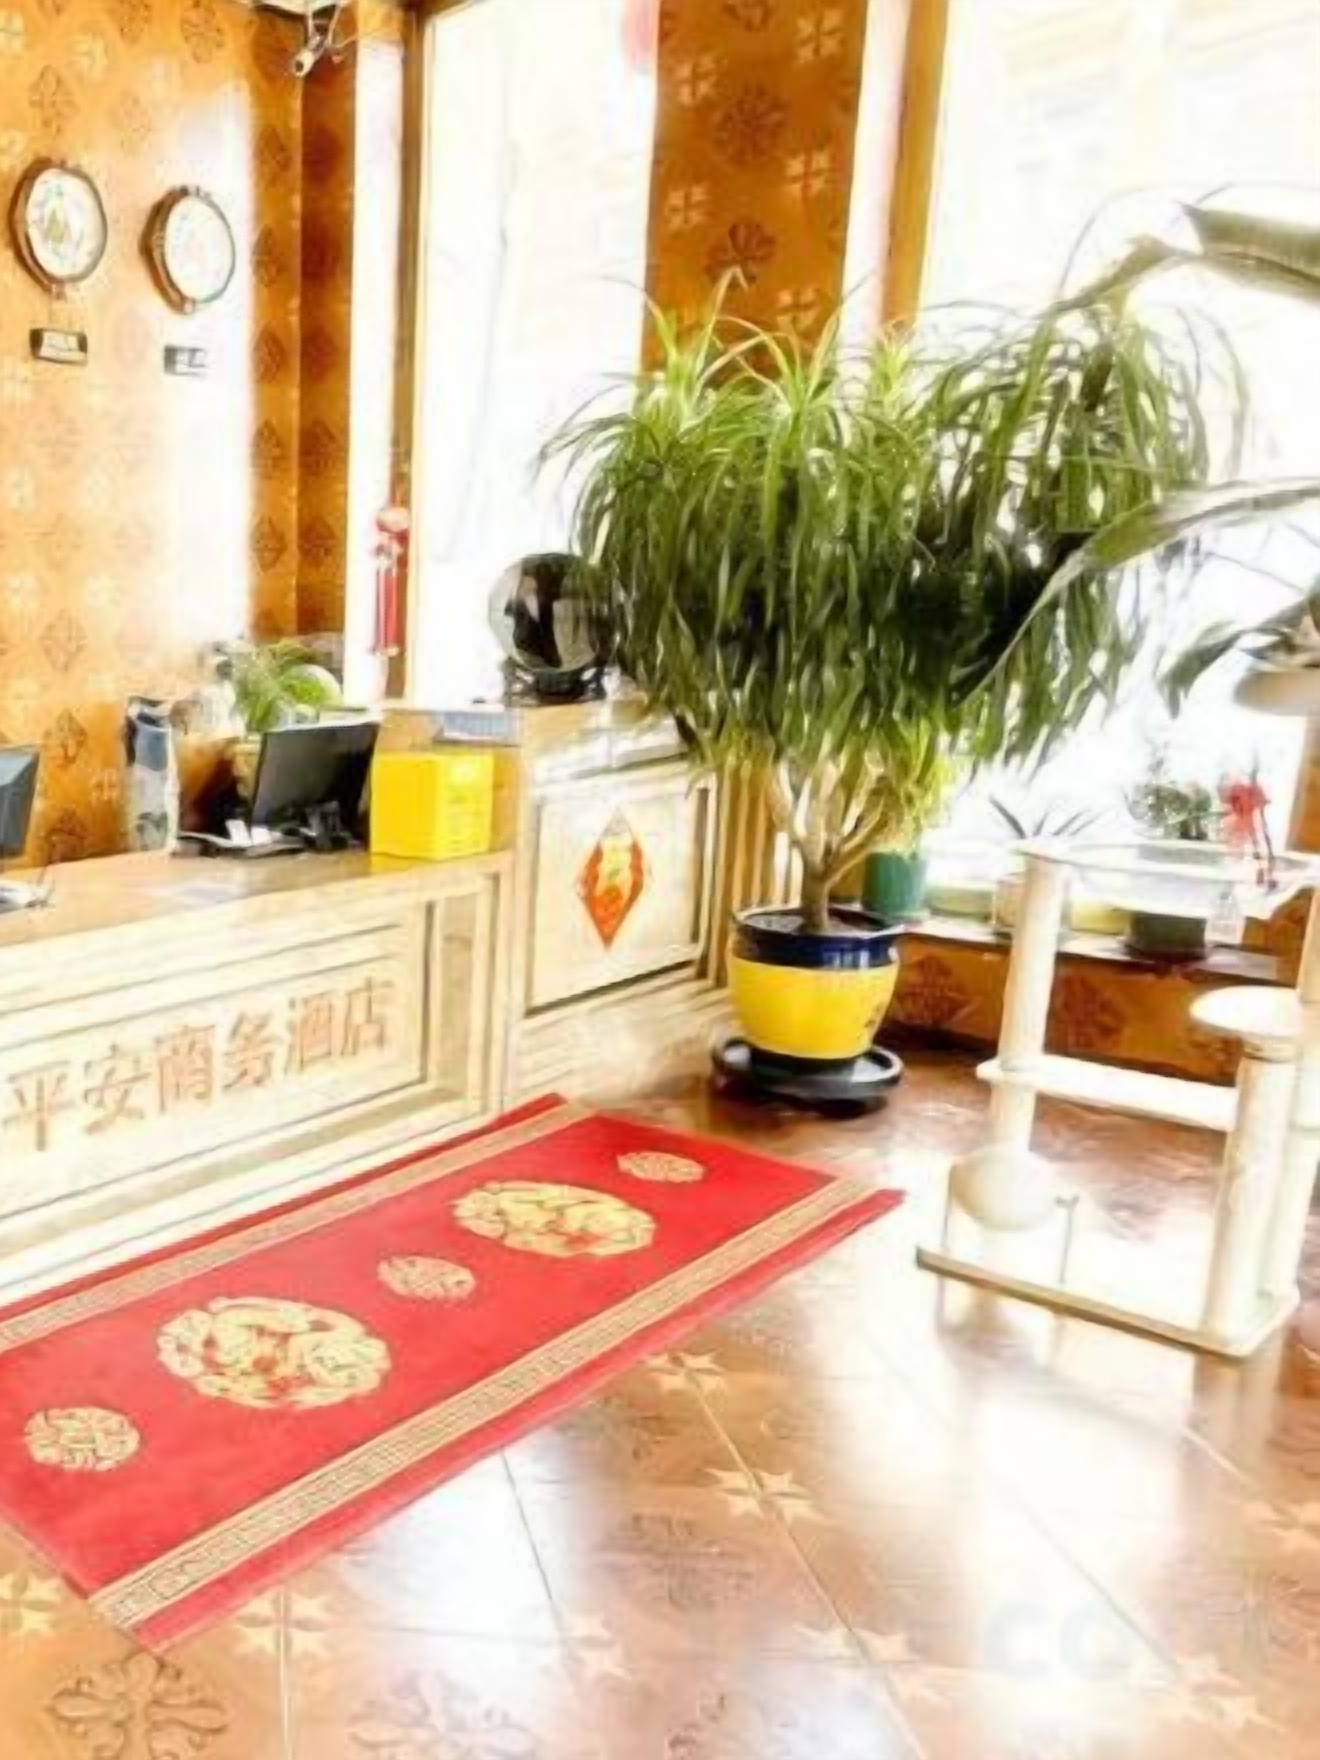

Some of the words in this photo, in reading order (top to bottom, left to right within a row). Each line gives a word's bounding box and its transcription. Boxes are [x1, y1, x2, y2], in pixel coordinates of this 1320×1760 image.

[1, 975, 395, 1152] 平安商务酒店
